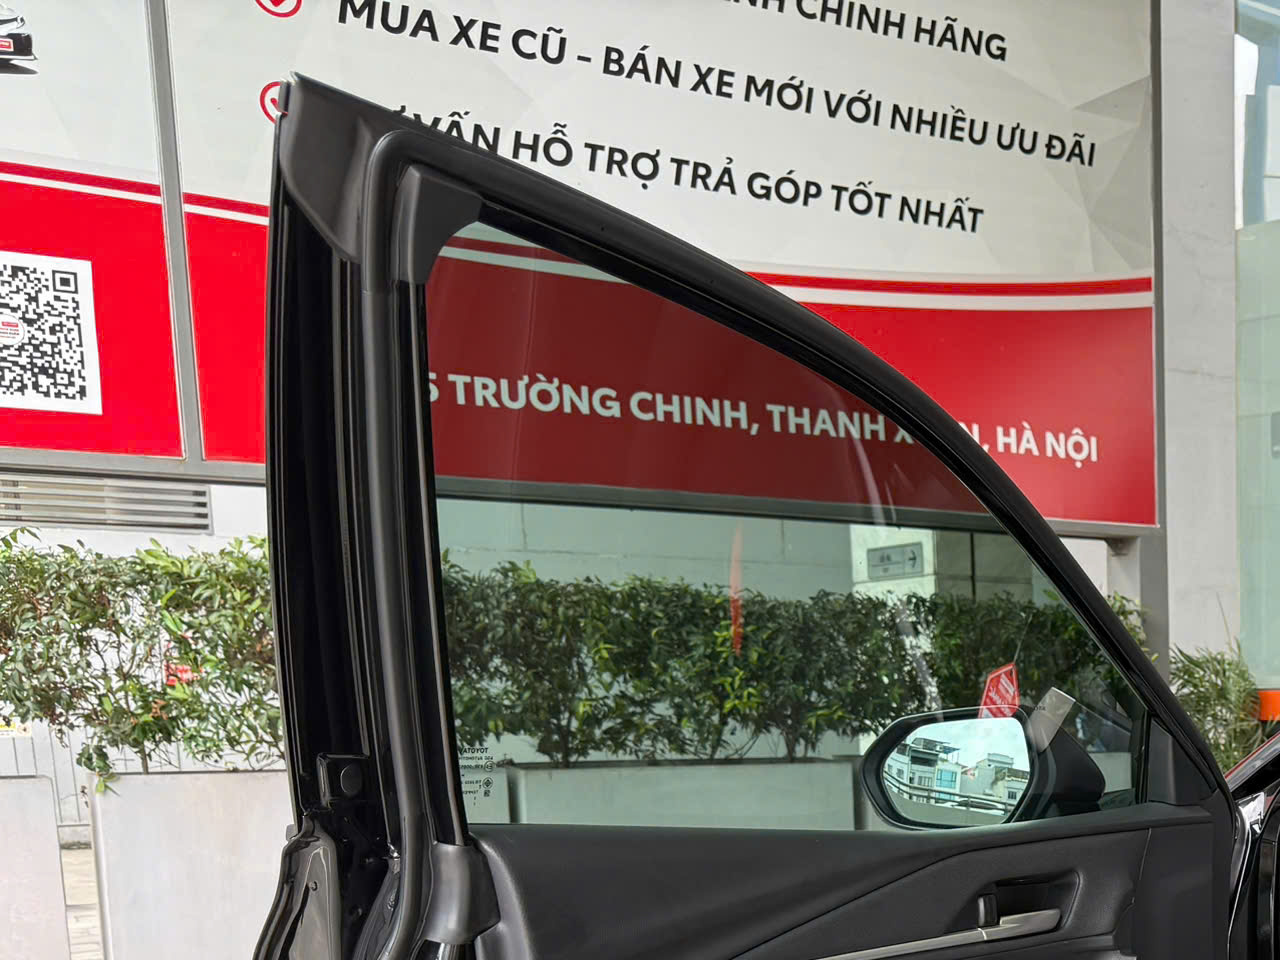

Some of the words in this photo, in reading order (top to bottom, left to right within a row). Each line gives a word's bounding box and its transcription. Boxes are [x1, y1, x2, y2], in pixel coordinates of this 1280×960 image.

[338, 0, 440, 42] MUA
[449, 15, 501, 53] XE
[511, 26, 567, 65] CŨ
[602, 45, 682, 88] BÁN
[690, 63, 735, 98] XE
[744, 75, 813, 114] MỚI
[824, 89, 881, 126] VỚI
[890, 103, 988, 146] NHIỀU
[997, 122, 1039, 155] ƯU
[1045, 133, 1096, 167] ĐÃI
[913, 16, 1008, 61] HÃNG
[512, 122, 574, 167] HỖ
[584, 142, 661, 190] TRỢ
[670, 157, 737, 195] TRẢ
[747, 170, 822, 207] GÓP
[830, 180, 892, 219] TỐT
[899, 196, 984, 233] NHẤT
[448, 373, 621, 418] TRƯỜNG
[630, 391, 759, 435] CHINH,
[767, 403, 886, 442] THANH
[996, 421, 1040, 458] HÀ
[1045, 428, 1098, 468] NỘI
